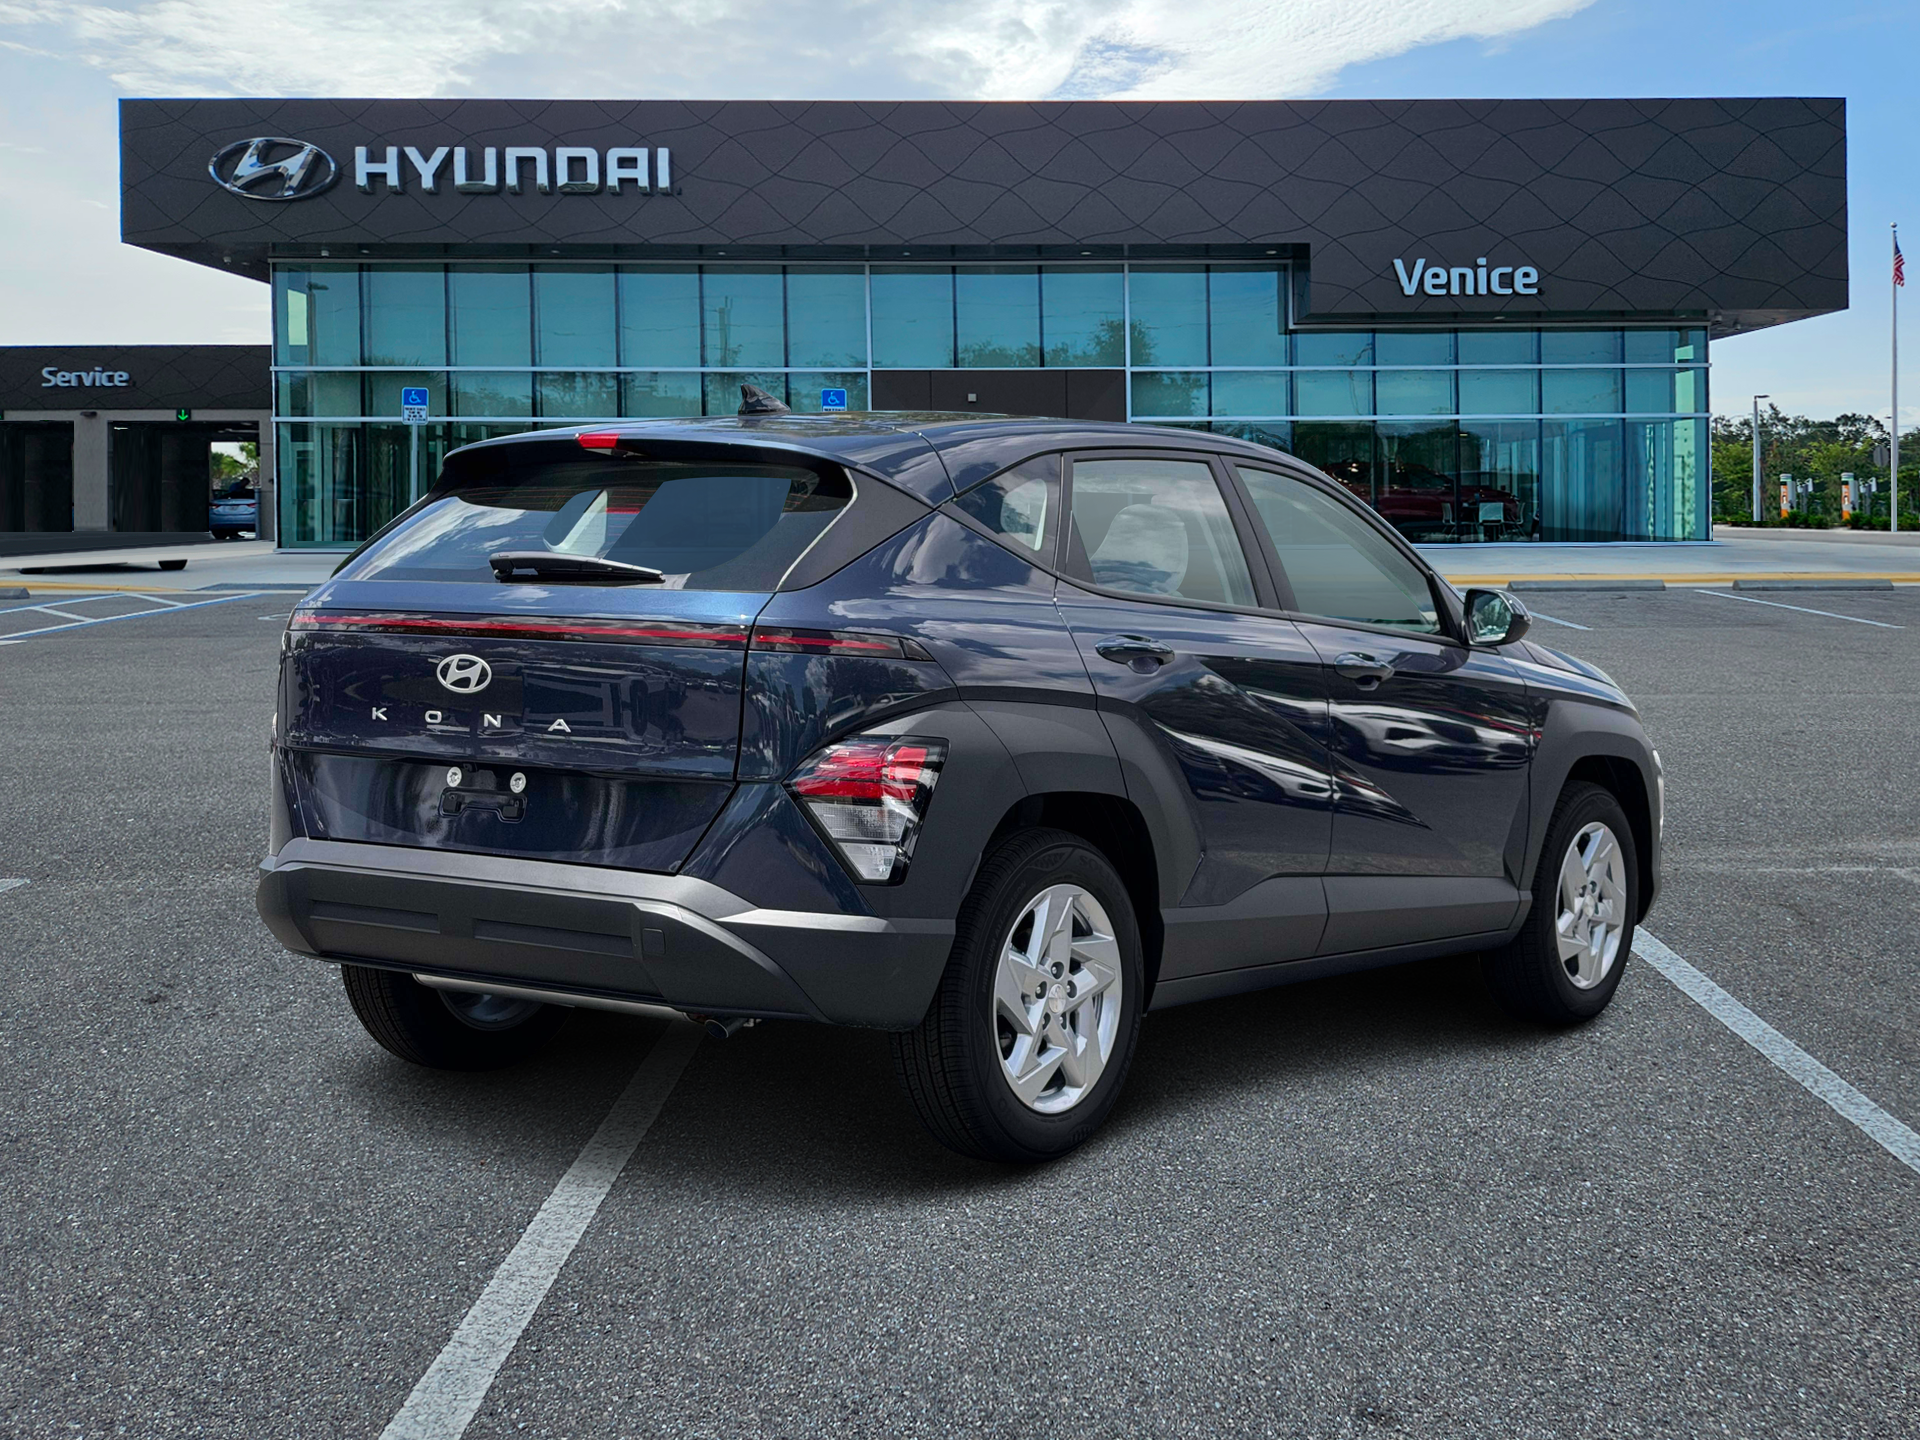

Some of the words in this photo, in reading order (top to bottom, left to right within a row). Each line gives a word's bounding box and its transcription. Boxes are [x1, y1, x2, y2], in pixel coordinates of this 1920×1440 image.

[354, 145, 672, 195] HYUNDAI
[1392, 257, 1540, 296] Venice
[41, 366, 130, 387] Service
[371, 706, 572, 733] KONA
